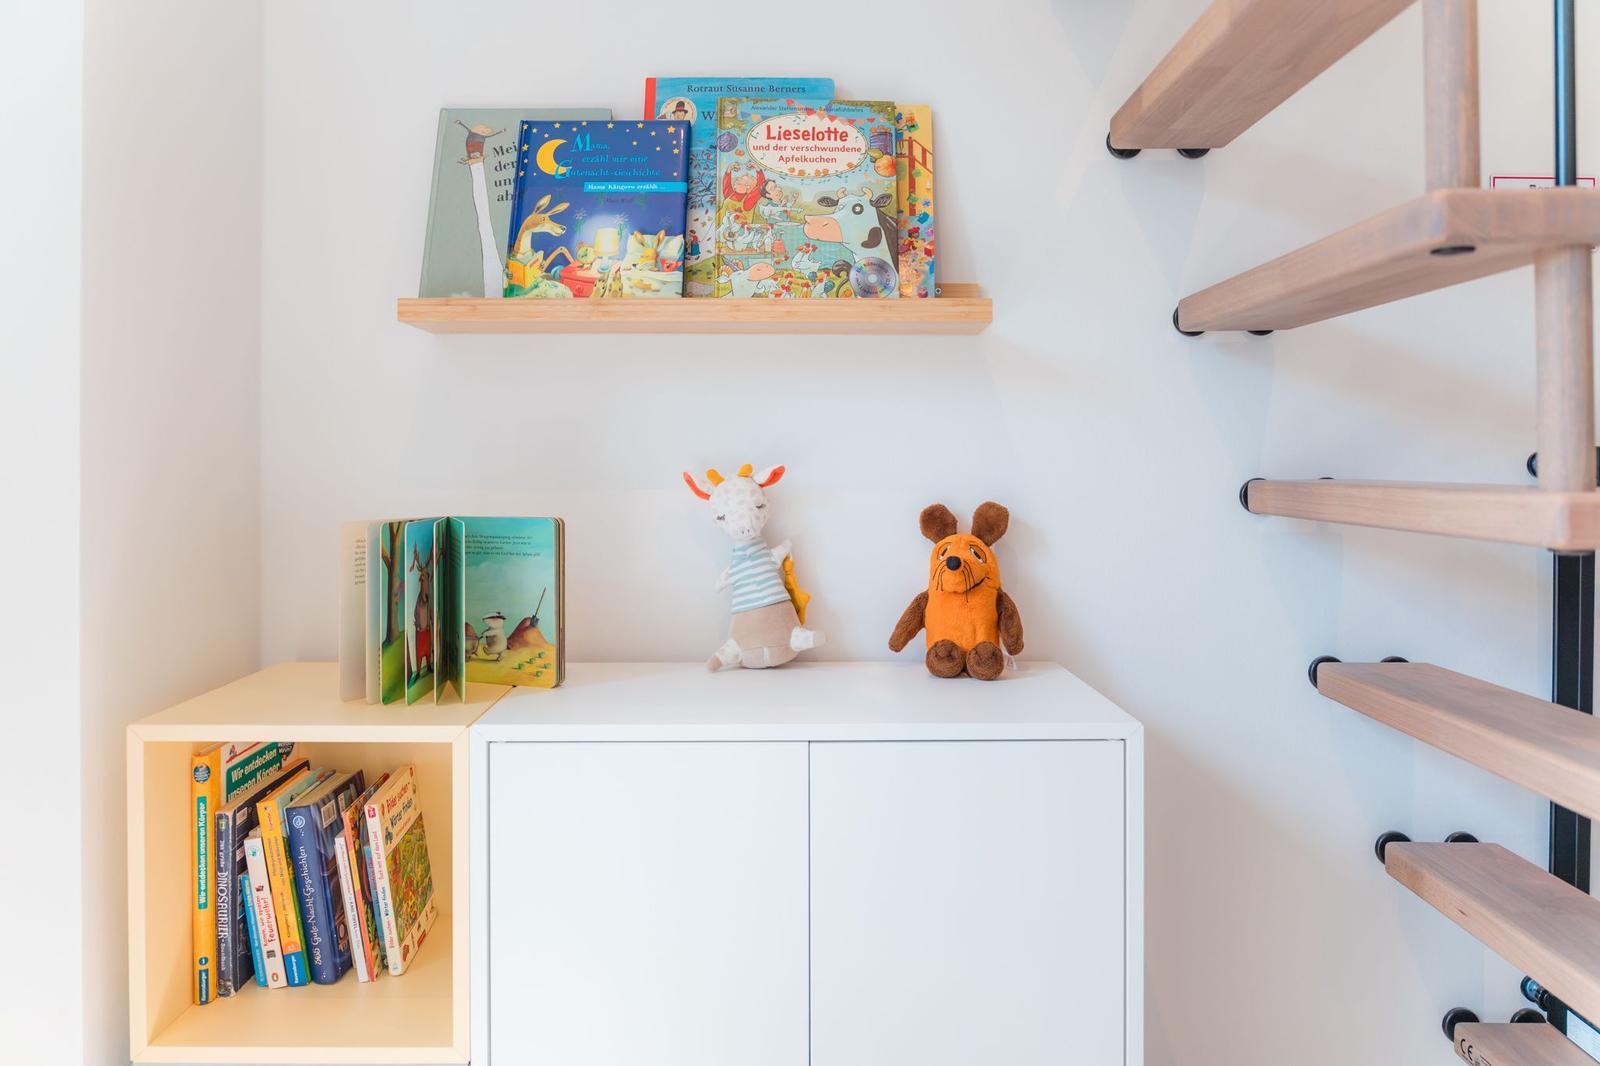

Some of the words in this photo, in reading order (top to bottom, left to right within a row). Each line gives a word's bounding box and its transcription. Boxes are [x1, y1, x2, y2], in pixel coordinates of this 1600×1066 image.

[687, 84, 723, 93] Rotraut
[726, 84, 765, 93] Susanne
[768, 84, 806, 93] Berners
[766, 125, 849, 142] Lieselotte
[778, 155, 837, 165] Apfelkuchen
[790, 145, 862, 153] verschwundene
[231, 766, 244, 783] Wir
[244, 749, 277, 774] entdecken
[227, 778, 256, 802] unseren
[198, 802, 207, 827] Körper
[198, 854, 207, 890] entdecken
[1460, 1038, 1473, 1061] CE
